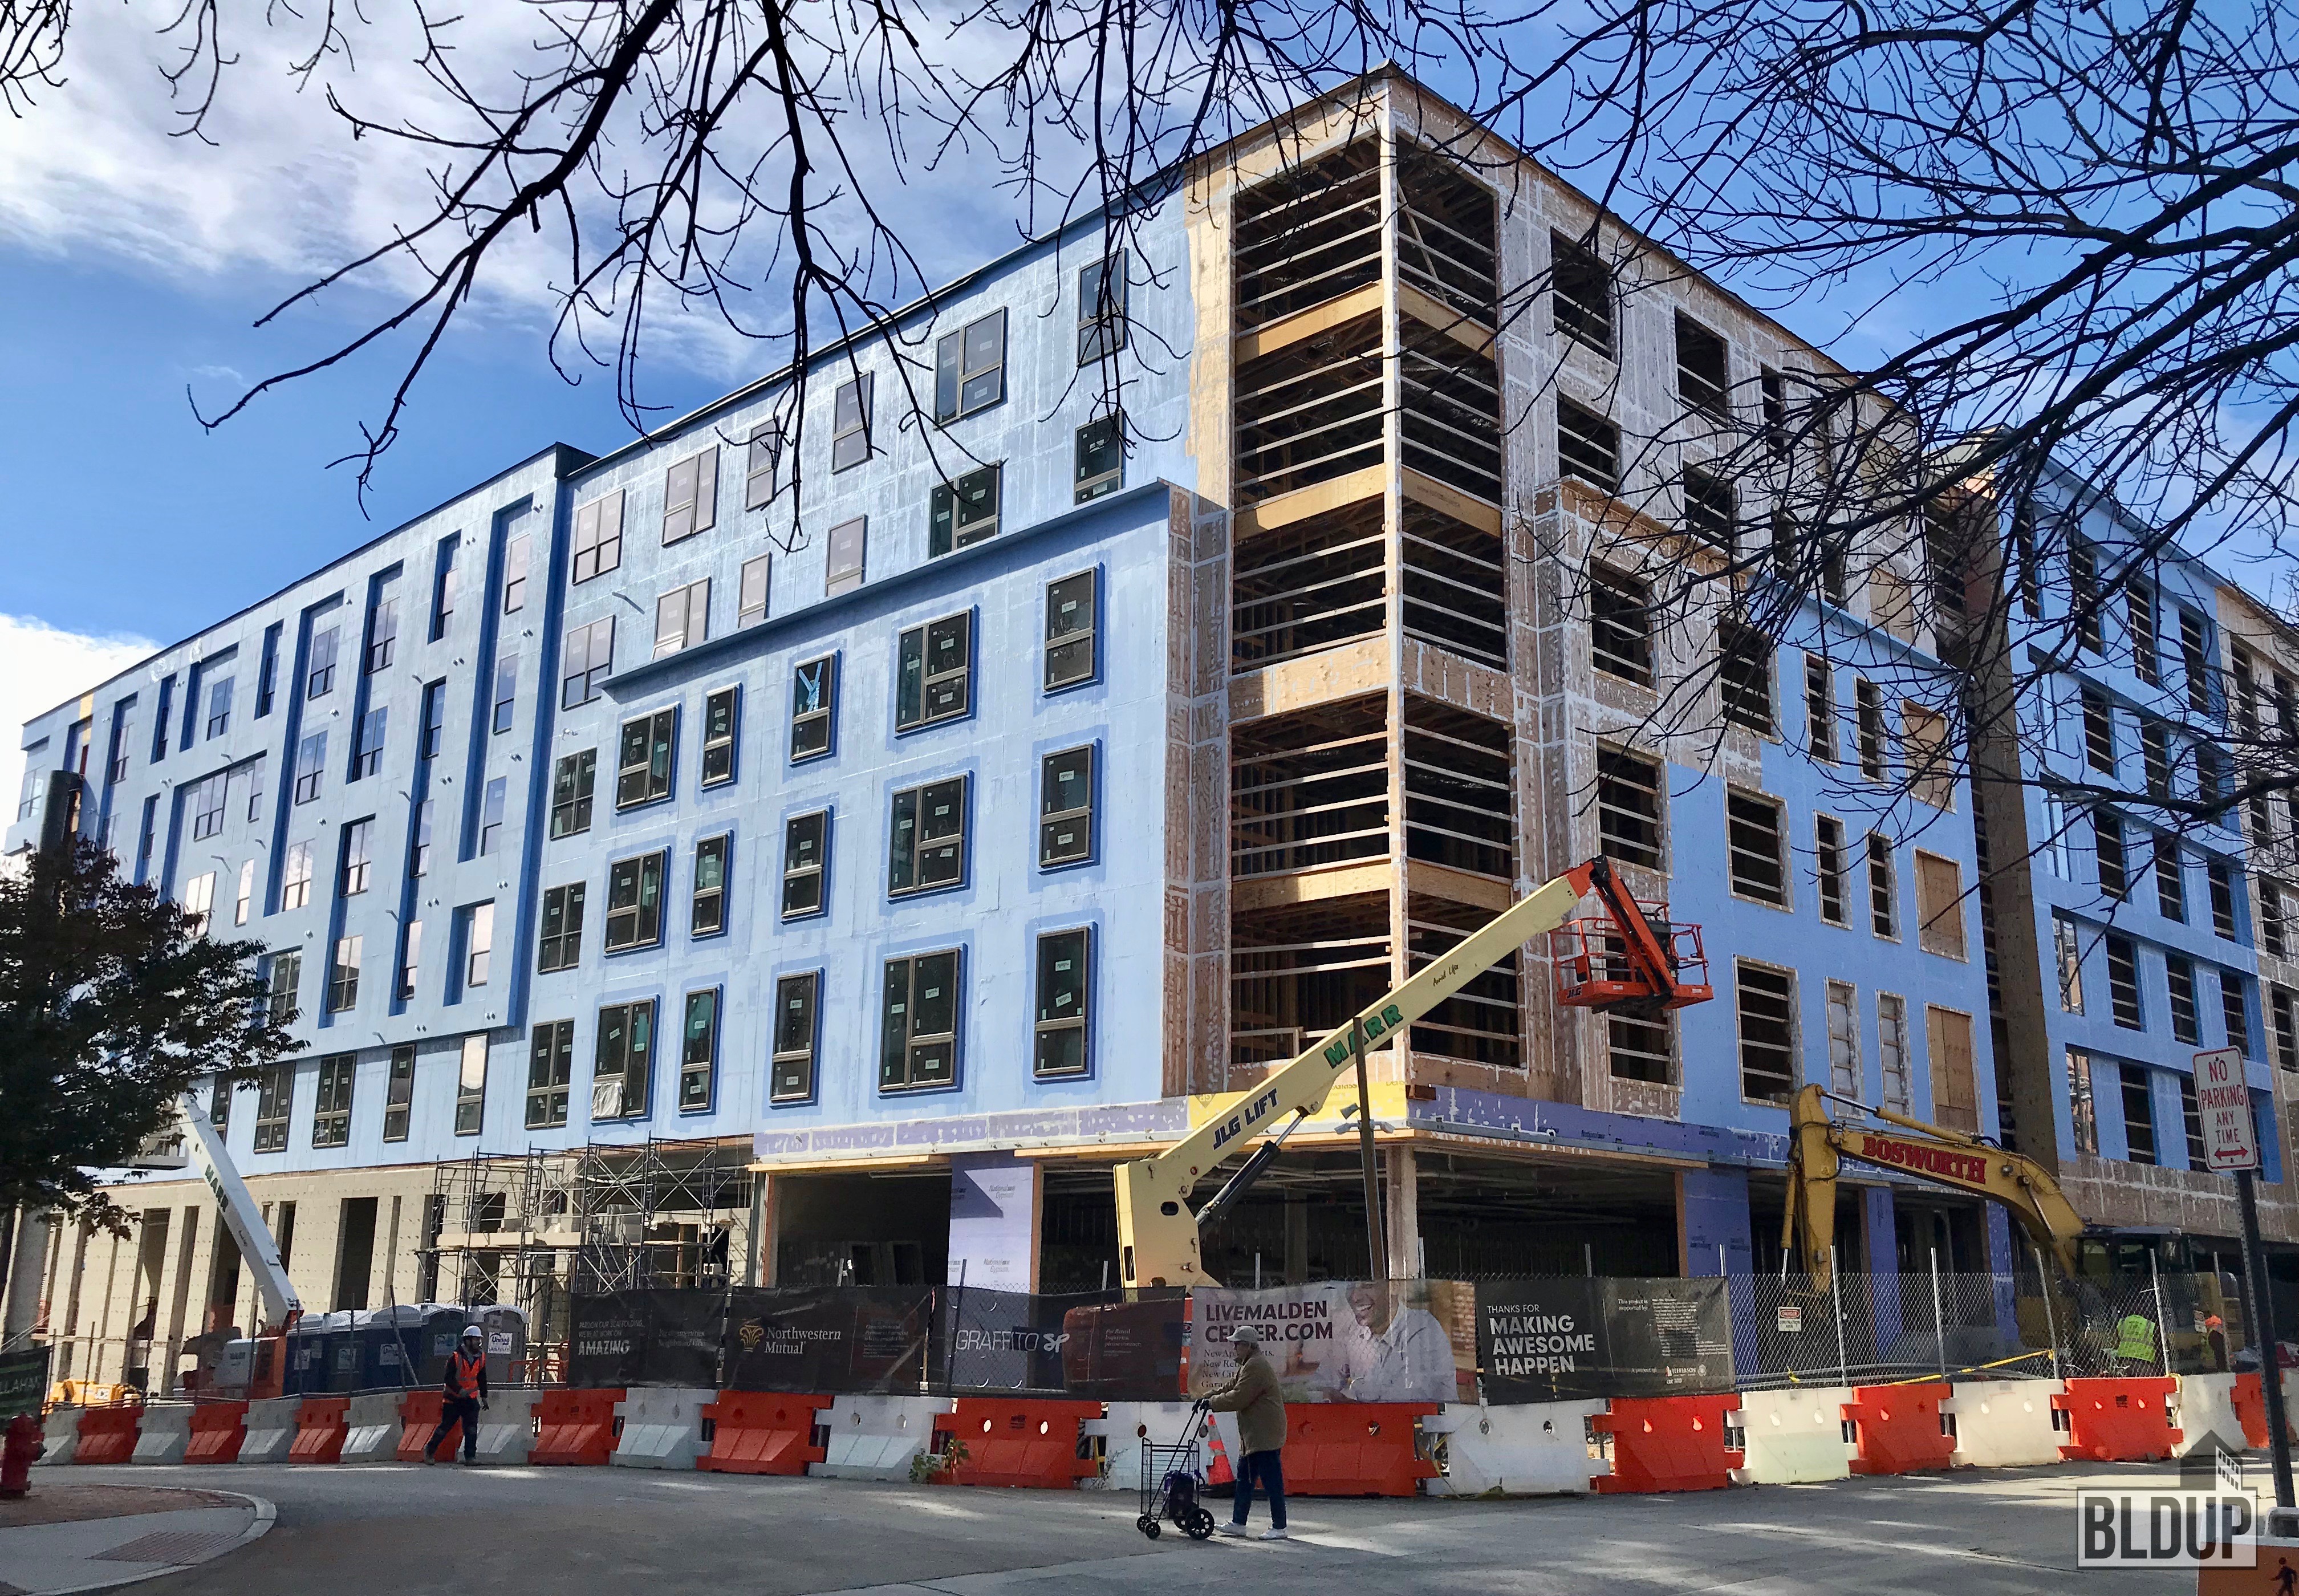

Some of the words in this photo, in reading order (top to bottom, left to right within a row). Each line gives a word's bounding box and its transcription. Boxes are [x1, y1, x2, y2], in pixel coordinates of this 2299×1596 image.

[1567, 987, 1582, 998] JLG
[2208, 1059, 2228, 1082] NO
[2200, 1085, 2244, 1110] PARKING
[1213, 1115, 1241, 1150] JLG
[1244, 1088, 1277, 1126] LIFT
[2216, 1110, 2234, 1127] ANY
[2216, 1128, 2240, 1143] TIME
[1862, 1136, 1987, 1184] BOSWORTH
[1206, 1301, 1327, 1321] LIVEMALDEN
[1487, 1305, 1520, 1314] THANKS
[766, 1327, 841, 1341] Northwestern
[1205, 1322, 1333, 1342] CEER.COM
[1489, 1315, 1574, 1334] MAKING
[578, 1339, 631, 1355] AMAZING
[956, 1330, 1039, 1351] GRAFFITO
[1493, 1334, 1595, 1355] AWESOME
[1494, 1355, 1575, 1375] HAPPEN
